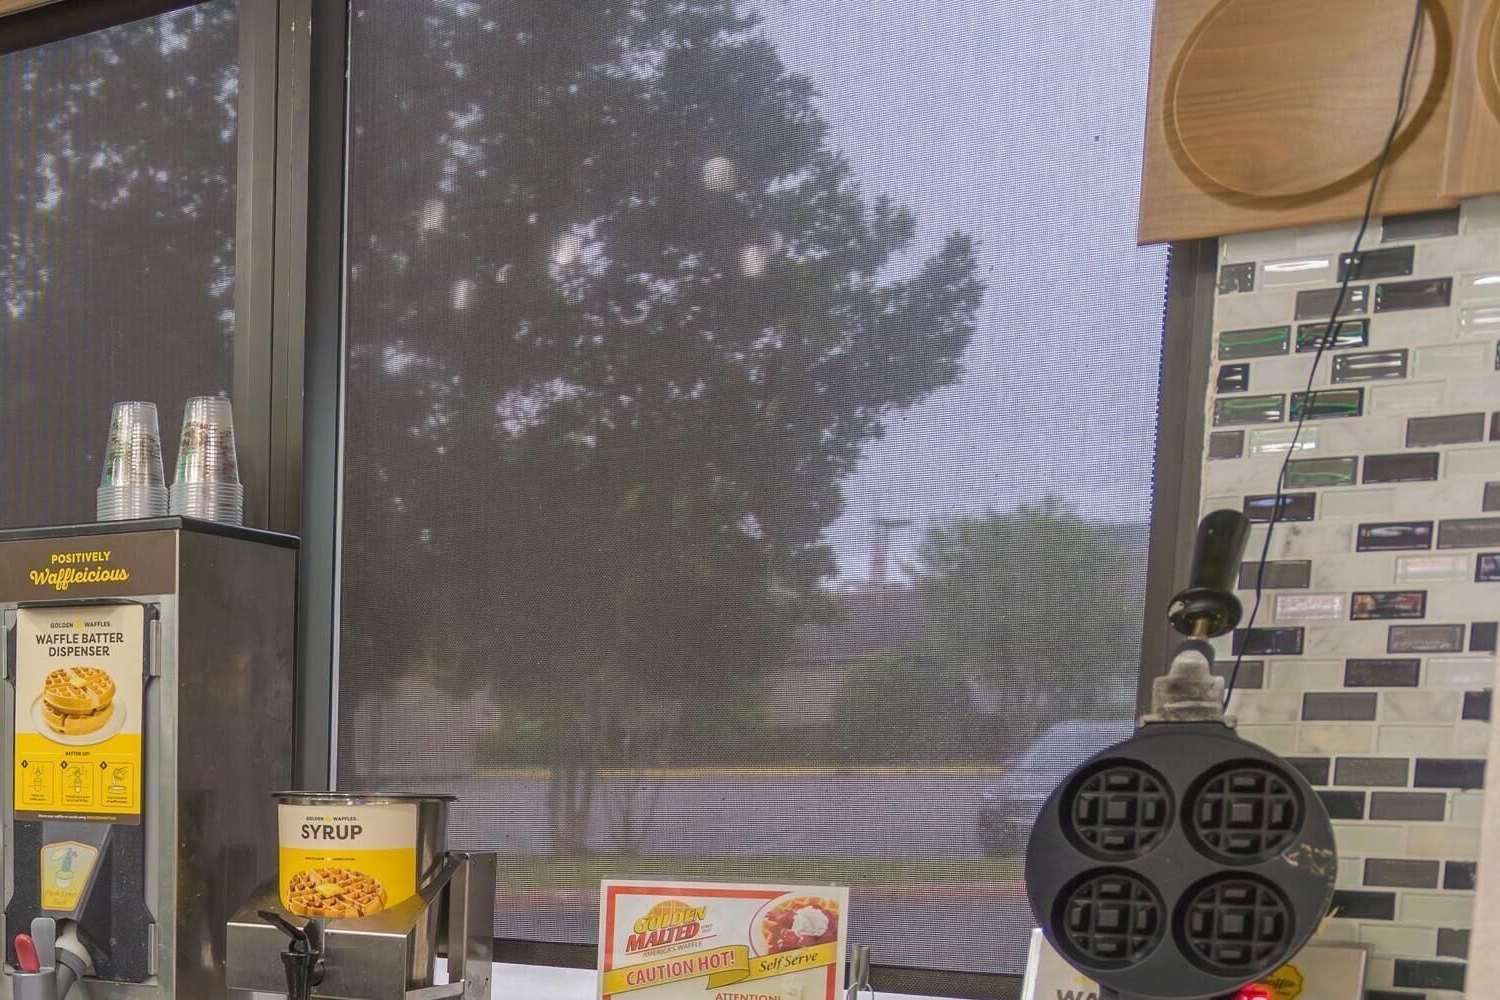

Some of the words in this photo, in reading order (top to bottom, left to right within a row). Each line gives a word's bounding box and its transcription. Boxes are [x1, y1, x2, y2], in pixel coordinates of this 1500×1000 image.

[51, 551, 111, 564] POSITIVELY
[29, 566, 129, 591] Waffleicious
[36, 633, 79, 644] WAFFLE
[81, 632, 124, 643] BATTER
[49, 646, 110, 657] DISPENSER
[301, 824, 363, 840] SYRUP
[634, 905, 707, 934] GOLDEN
[626, 922, 701, 952] MALTED
[643, 946, 677, 958] AMERICA'S
[678, 941, 703, 952] WAFFLE
[626, 961, 695, 986] CAUTION
[698, 950, 735, 971] HOT!
[758, 957, 783, 974] Self
[784, 953, 819, 968] Serve
